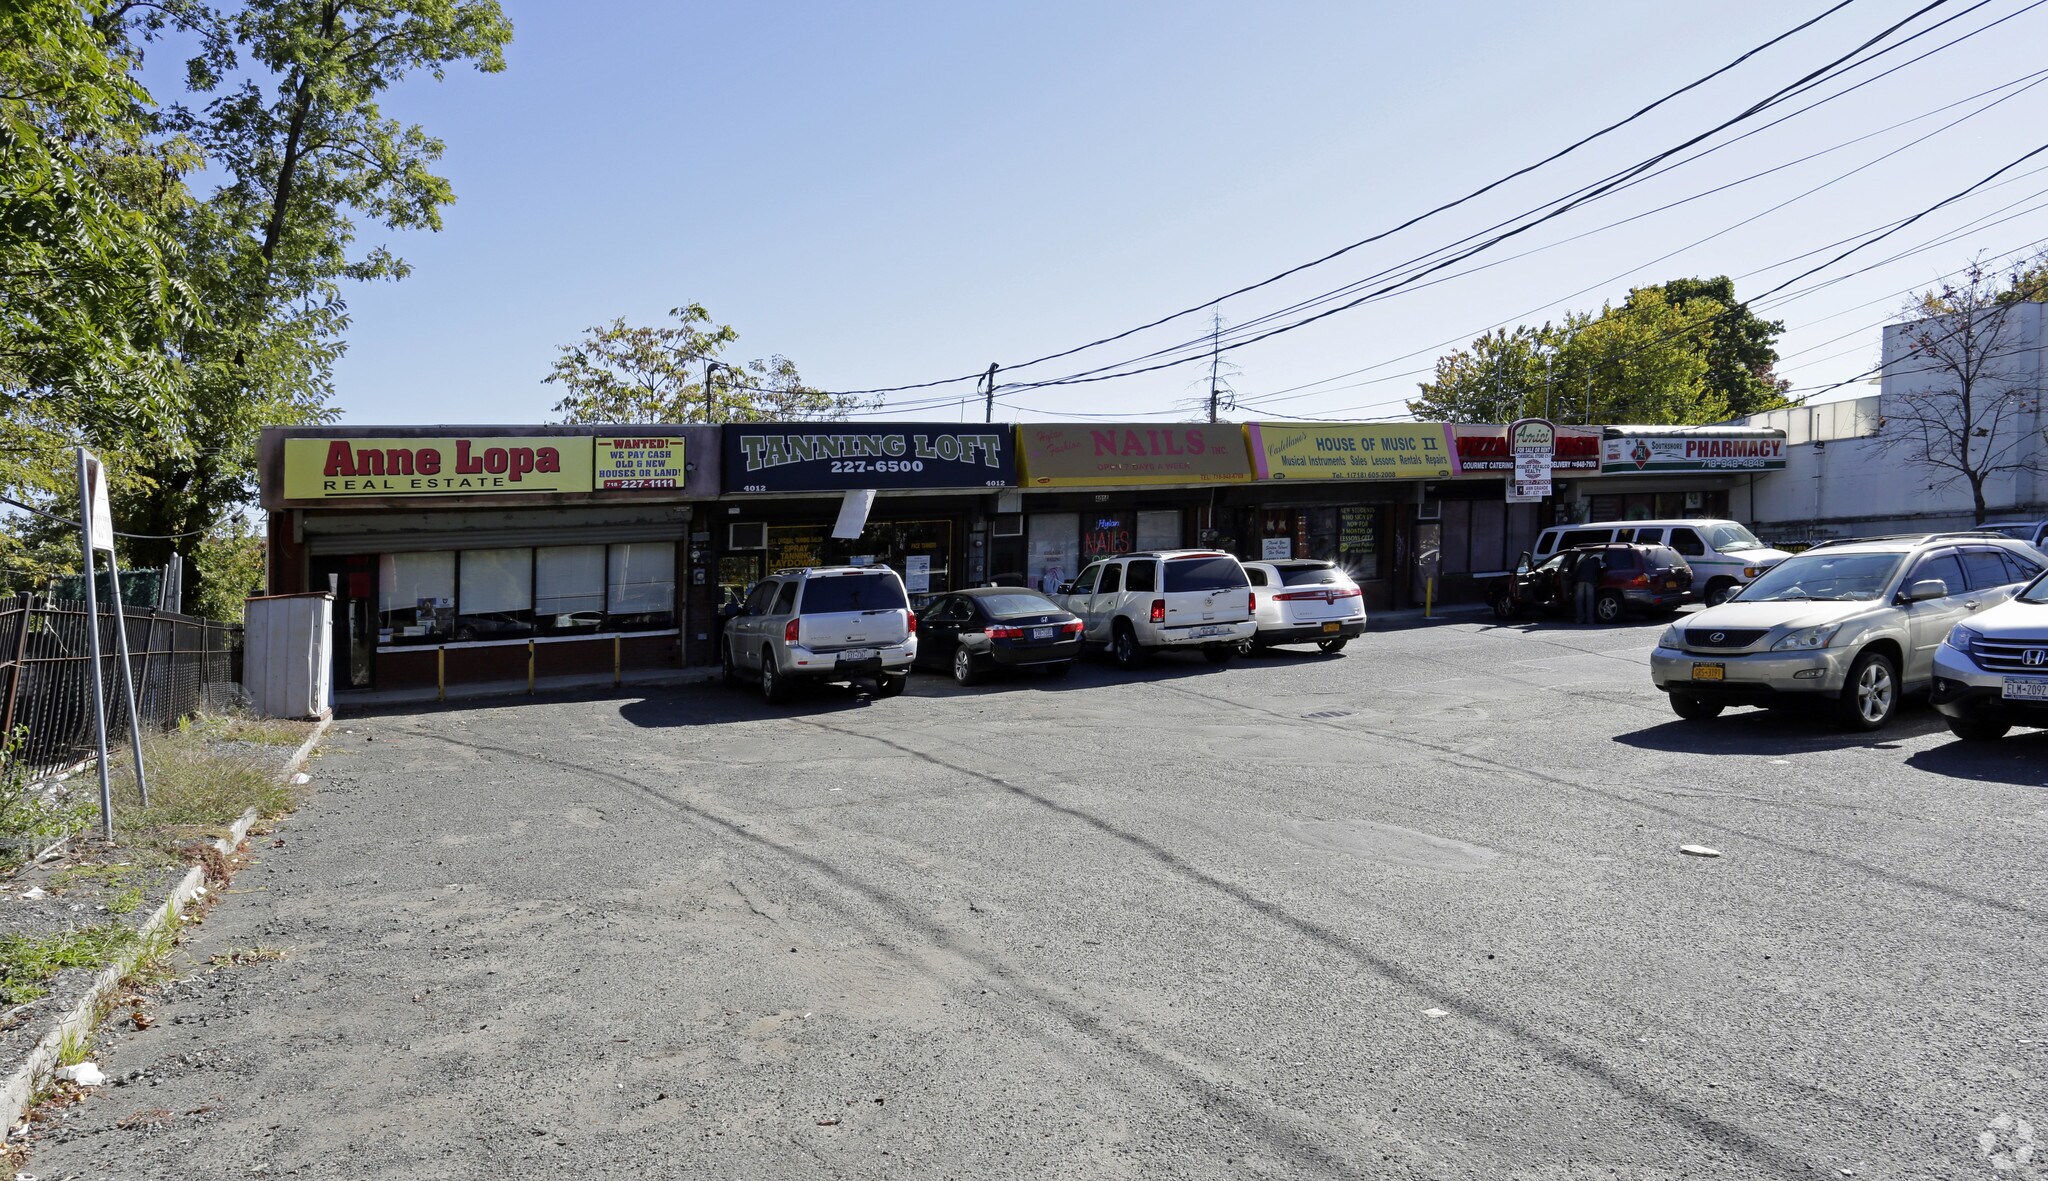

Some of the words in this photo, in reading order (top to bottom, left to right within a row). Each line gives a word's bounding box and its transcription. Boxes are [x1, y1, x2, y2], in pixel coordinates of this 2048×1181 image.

[1516, 425, 1550, 443] Amici
[613, 438, 669, 449] WANTED!
[1090, 429, 1206, 456] NAILS
[1316, 437, 1356, 451] HOUSE
[1361, 437, 1375, 451] OF
[1381, 437, 1416, 450] MUSIC
[1421, 437, 1438, 450] II
[610, 451, 624, 459] WE
[627, 450, 645, 459] PAY
[648, 450, 672, 458] CASH
[740, 434, 906, 471] TANNING
[913, 434, 1001, 469] LOFT
[1685, 440, 1781, 458] PHARMACY
[323, 440, 441, 476] Anne
[455, 439, 561, 482] Lopa
[615, 460, 634, 468] OLD
[636, 460, 643, 468] &
[645, 459, 666, 468] NEW
[830, 460, 924, 473] 227-6500
[1166, 462, 1191, 470] WEEK
[1281, 455, 1307, 466] Musical
[1308, 455, 1347, 466] Instruments
[1350, 455, 1367, 466] Sales
[1371, 455, 1396, 466] Lessons
[1400, 454, 1422, 465] Rentals
[1425, 454, 1447, 467] Repairs
[1462, 461, 1488, 469] GOURMET
[1489, 461, 1514, 469] CATERING
[1701, 459, 1765, 468] 718-948-4848
[599, 470, 636, 478] HOUSES
[638, 469, 651, 477] OR
[654, 468, 681, 477] LAND!
[323, 480, 394, 490] REAL
[410, 477, 504, 489] ESTATE
[1095, 519, 1120, 530] Hylan
[1085, 530, 1130, 553] NAILS
[783, 545, 809, 553] SPRAY
[780, 552, 812, 560] TANNING
